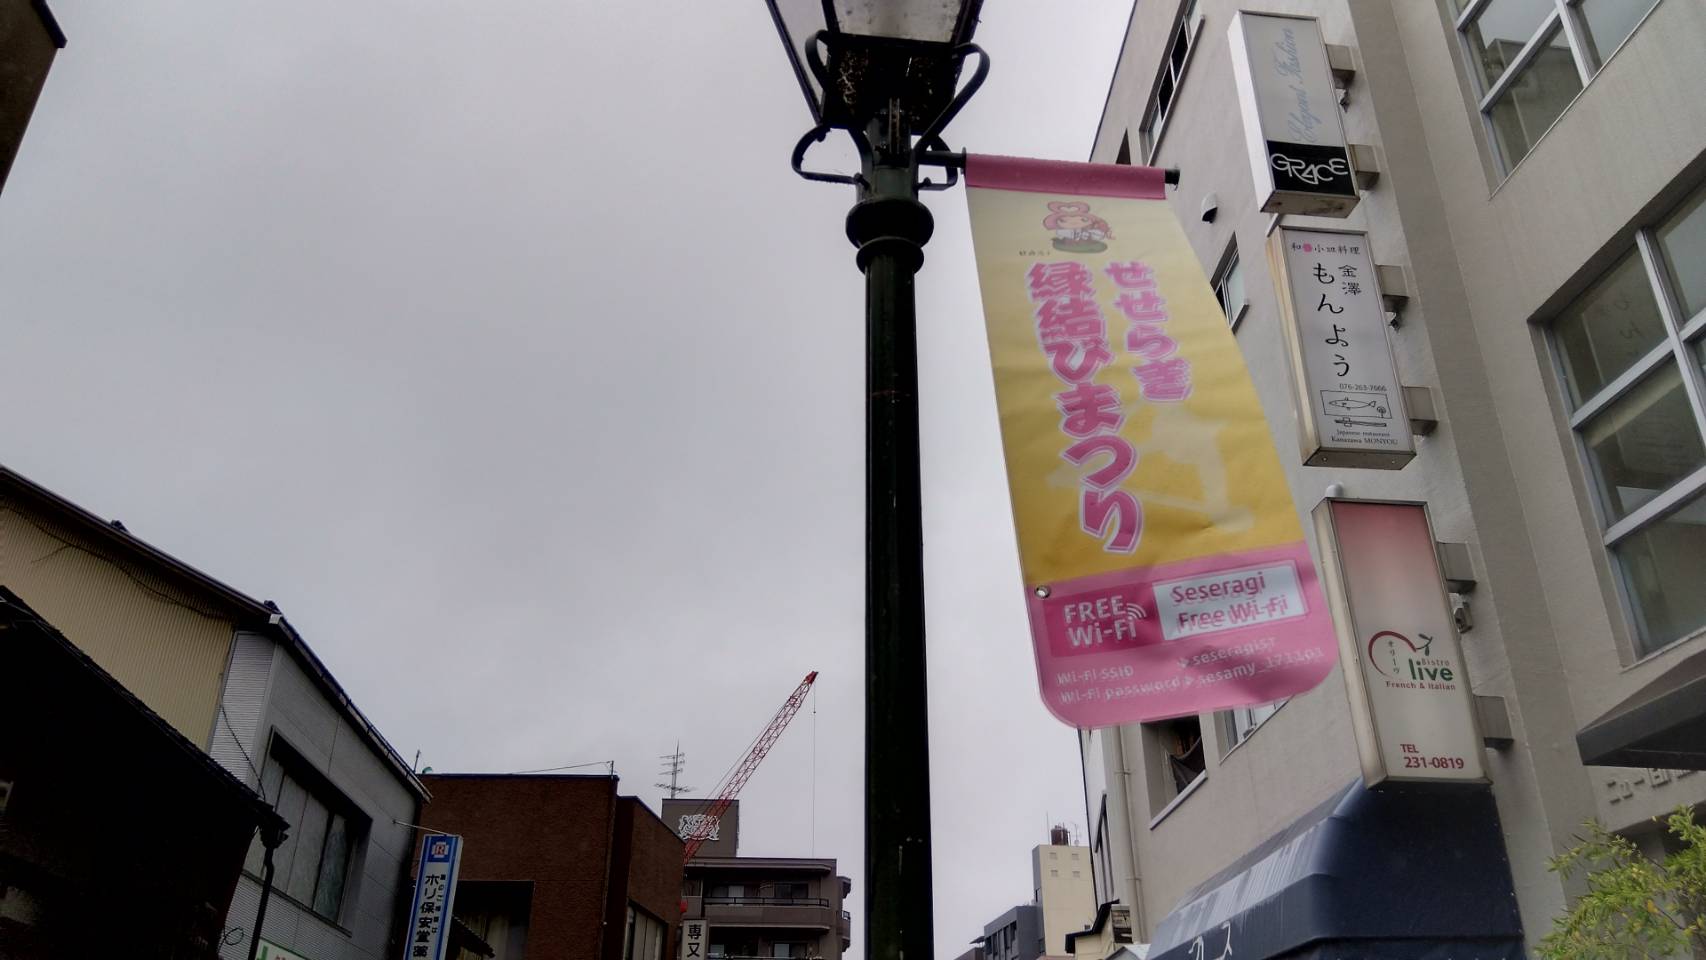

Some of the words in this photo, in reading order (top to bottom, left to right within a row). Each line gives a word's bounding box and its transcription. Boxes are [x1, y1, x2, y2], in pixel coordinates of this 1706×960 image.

[1271, 153, 1348, 185] GRACE
[1338, 264, 1362, 296] 金澤
[1105, 261, 1192, 402] せせらぎ
[1313, 262, 1350, 377] もんよう
[1025, 261, 1143, 555] 縁結びまつり
[1171, 572, 1266, 604] Seseragi
[1064, 595, 1128, 624] FREE
[1178, 609, 1226, 632] Free
[1229, 595, 1288, 623] Wi-Fi
[1067, 620, 1137, 648] Wi-Fi
[1105, 676, 1180, 701] password
[1386, 680, 1417, 689] French
[1401, 744, 1419, 754] TEL
[1404, 757, 1465, 769] 231-0819
[413, 874, 440, 958] ホリ保安堂薬
[687, 924, 702, 958] 専又
